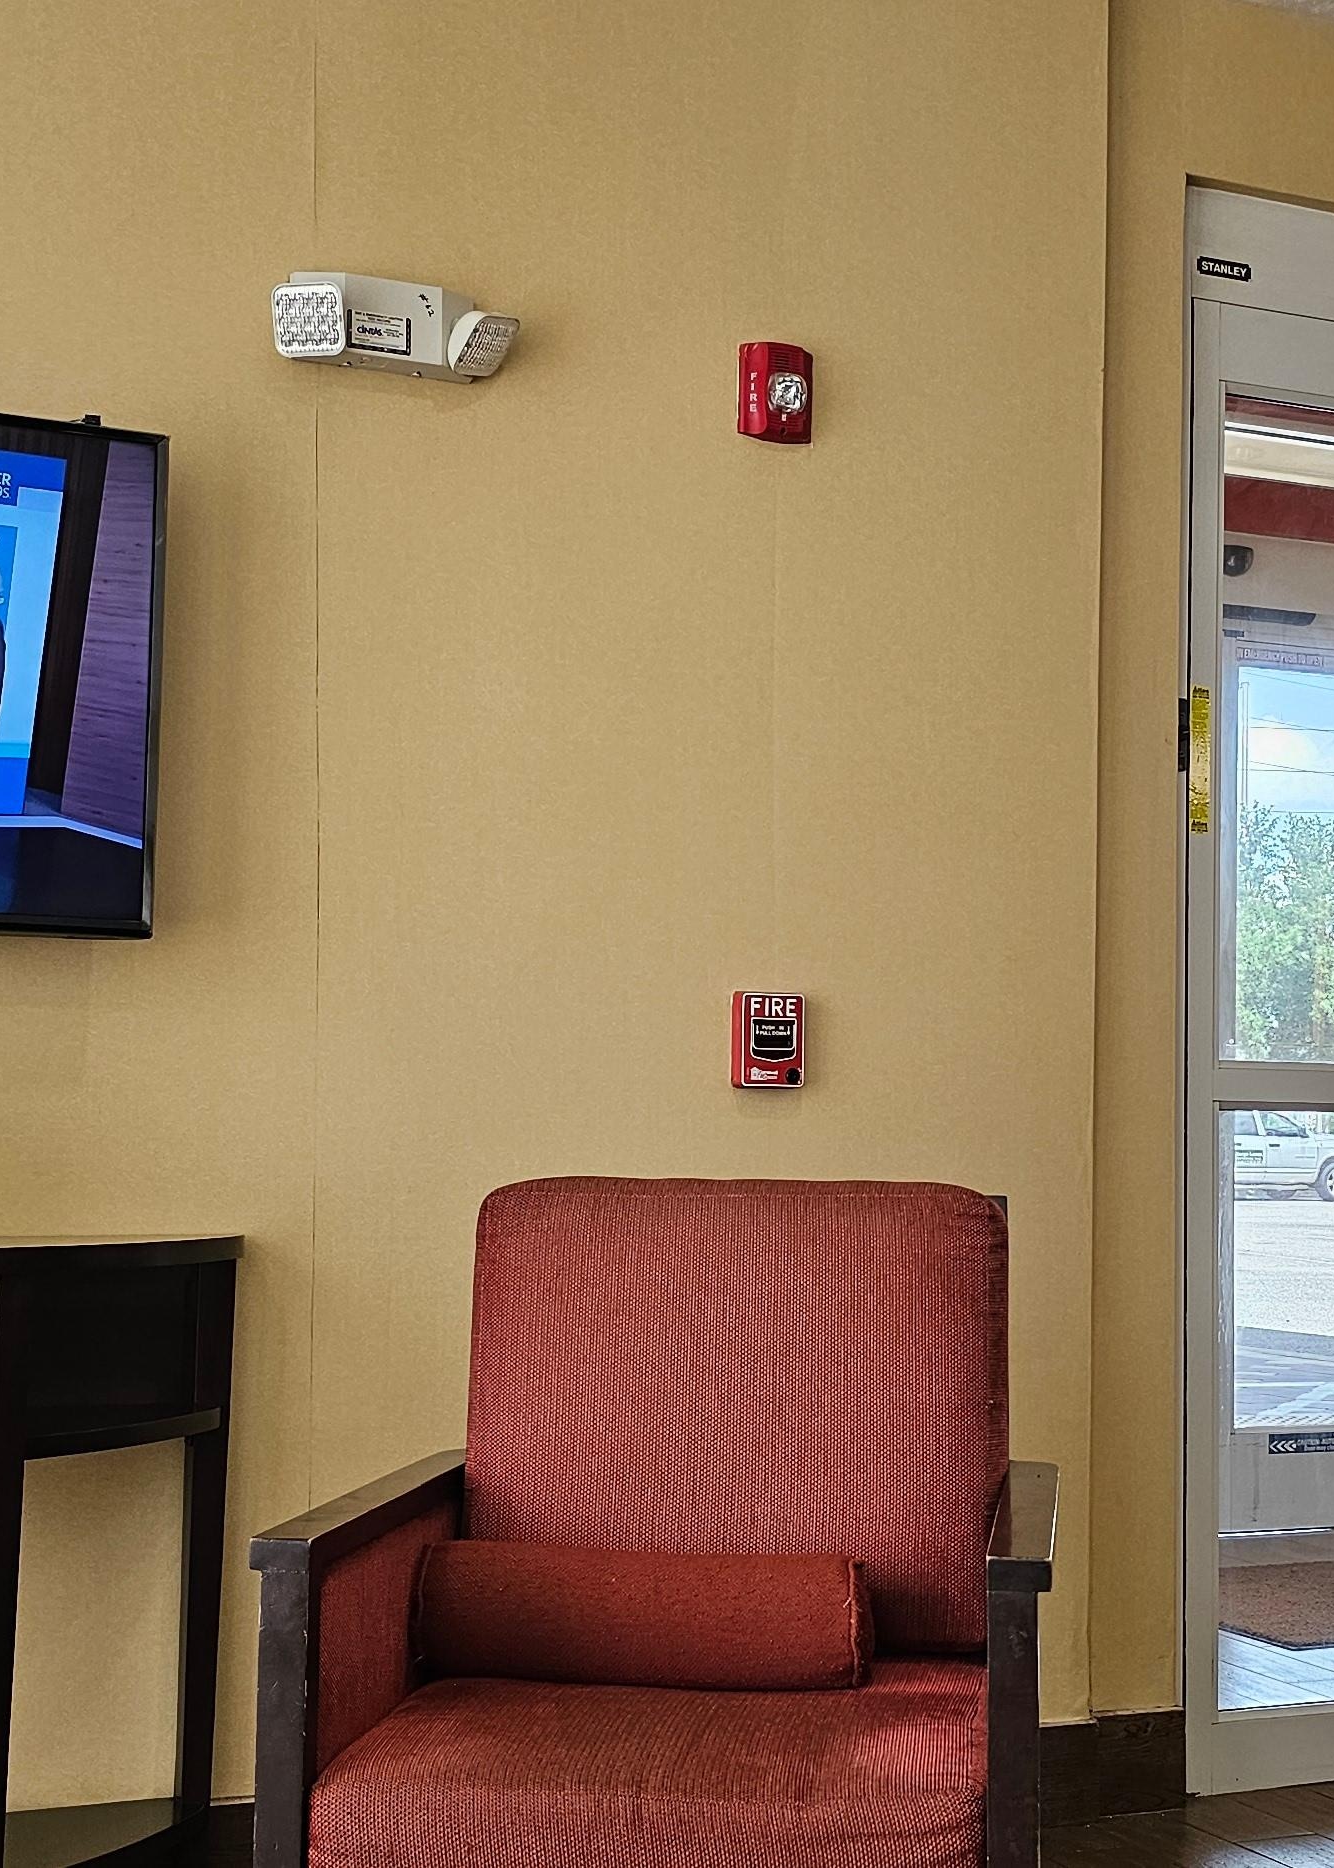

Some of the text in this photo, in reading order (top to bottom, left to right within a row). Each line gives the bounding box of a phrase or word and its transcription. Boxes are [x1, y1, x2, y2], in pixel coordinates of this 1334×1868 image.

[1201, 261, 1247, 277] STANLEY
[749, 372, 758, 412] FIRE
[750, 997, 798, 1017] FIRE
